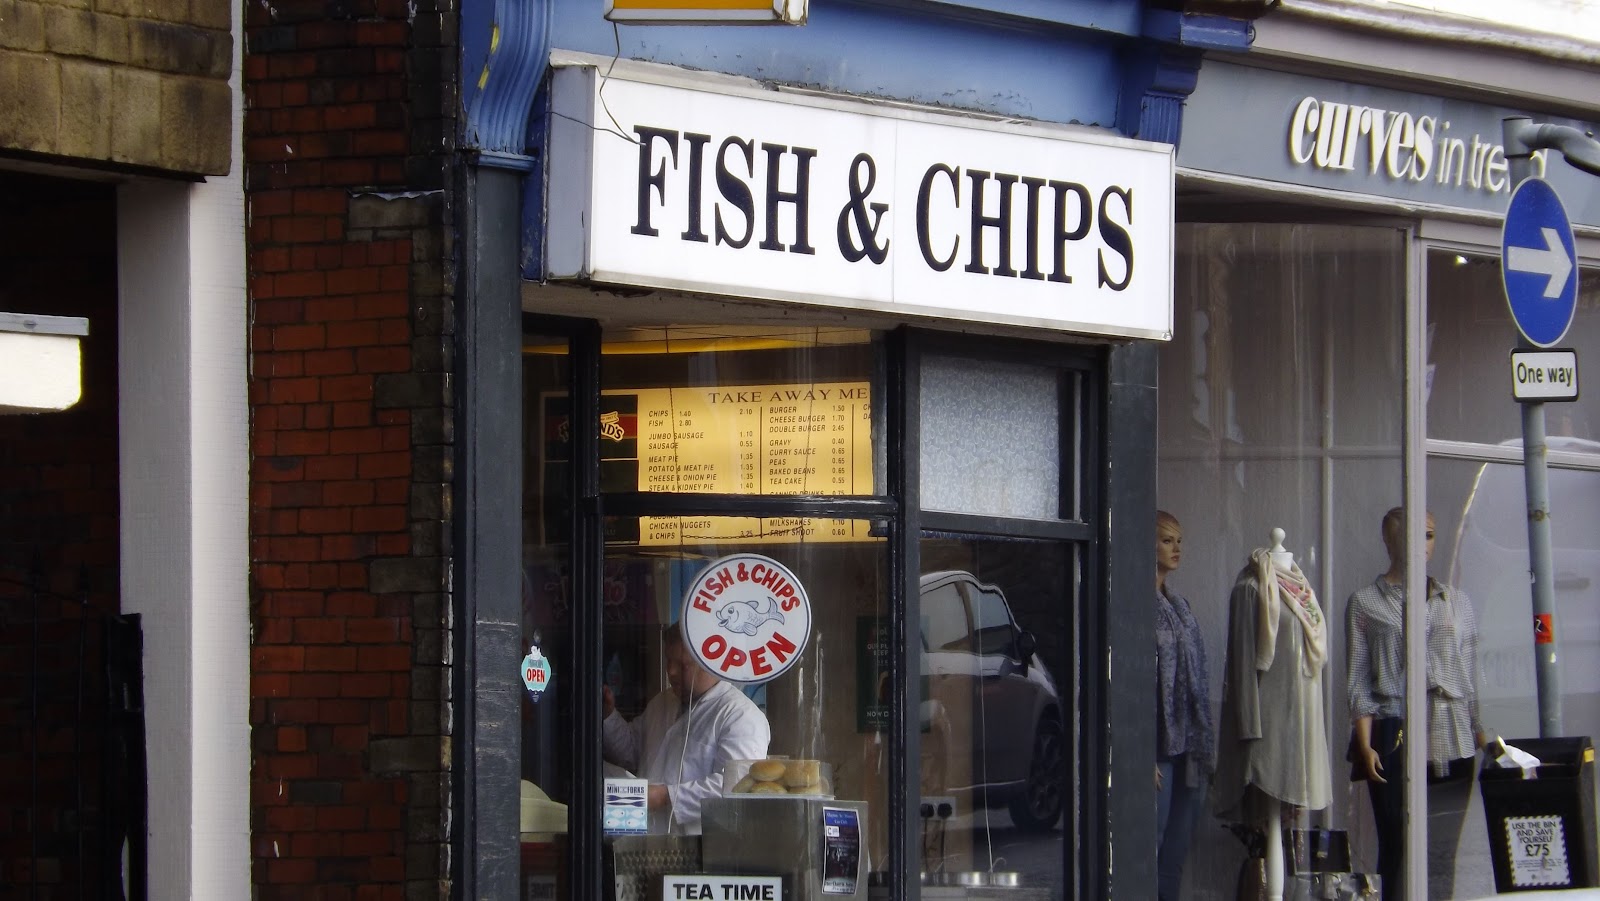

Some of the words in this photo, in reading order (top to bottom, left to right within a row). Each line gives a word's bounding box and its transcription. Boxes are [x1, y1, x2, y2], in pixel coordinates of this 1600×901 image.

[1290, 96, 1437, 182] curves
[1437, 121, 1465, 185] in
[631, 125, 817, 255] FISH
[837, 152, 890, 265] &
[916, 162, 1134, 292] CHIPS
[1517, 362, 1543, 383] One
[1548, 367, 1572, 387] way
[708, 392, 762, 403] TAKE
[770, 389, 831, 401] AWAY
[840, 388, 867, 399] ME
[770, 425, 796, 433] DOUBLE
[798, 424, 826, 432] BURGER
[649, 522, 678, 530] CHICKEN
[680, 521, 711, 529] NUGGETS
[770, 529, 789, 537] FRUIT
[693, 567, 735, 613] FISH
[737, 562, 749, 582] &
[751, 564, 801, 612] CHIPS
[701, 631, 797, 676] OPEN
[527, 668, 545, 683] OPEN
[607, 786, 619, 794] MINI
[628, 786, 645, 794] FORKS
[1525, 844, 1550, 857] £75
[673, 884, 714, 900] TEA
[721, 885, 774, 900] TIME
